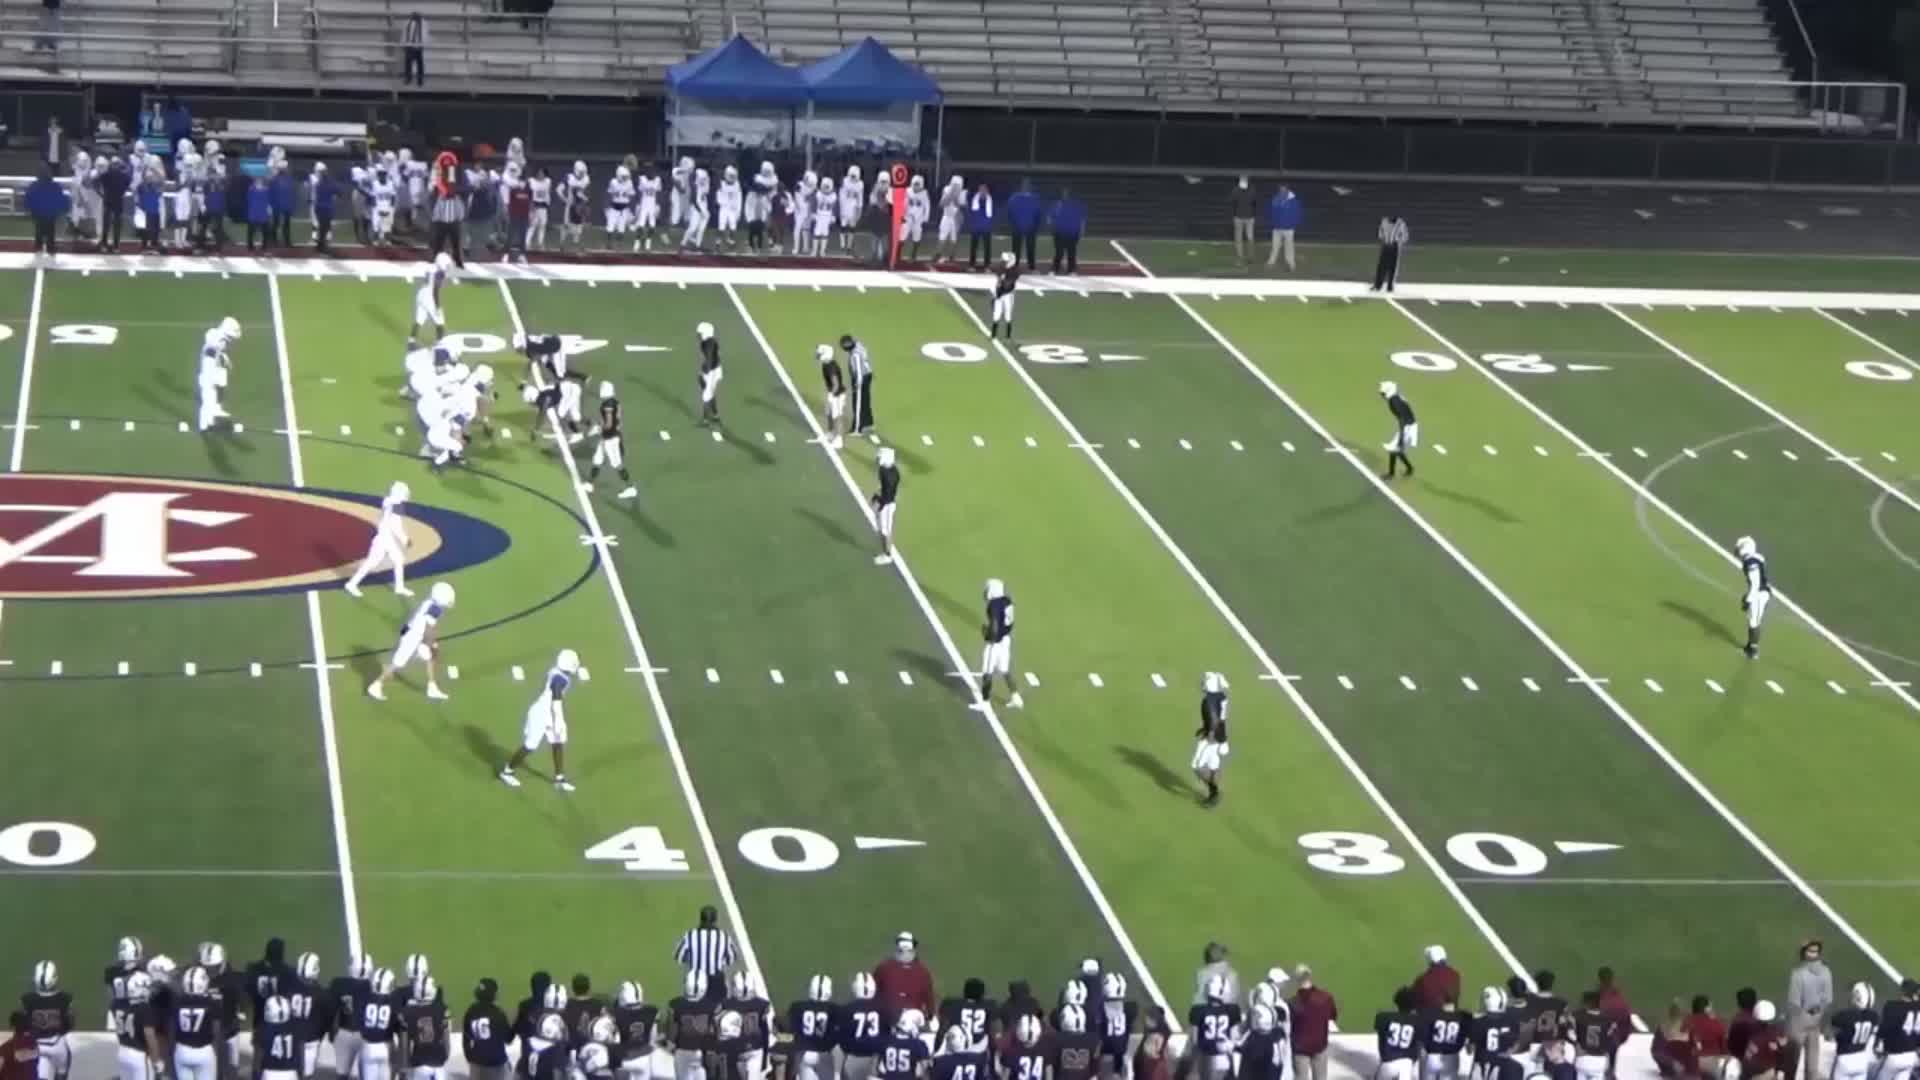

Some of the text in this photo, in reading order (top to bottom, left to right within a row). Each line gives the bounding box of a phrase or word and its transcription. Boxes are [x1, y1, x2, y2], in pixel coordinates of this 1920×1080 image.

[291, 993, 313, 1019] 91
[364, 1003, 391, 1030] 99
[179, 1007, 205, 1033] 67
[802, 1010, 828, 1037] 93
[853, 1011, 880, 1038] 73
[960, 1008, 987, 1034] 52
[1204, 1014, 1230, 1041] 32
[1433, 1019, 1460, 1044] 38
[1852, 1020, 1873, 1045] 10
[271, 1034, 293, 1059] 41
[1387, 1022, 1414, 1049] 39
[885, 1047, 910, 1072] 85
[1018, 1055, 1044, 1080] 34
